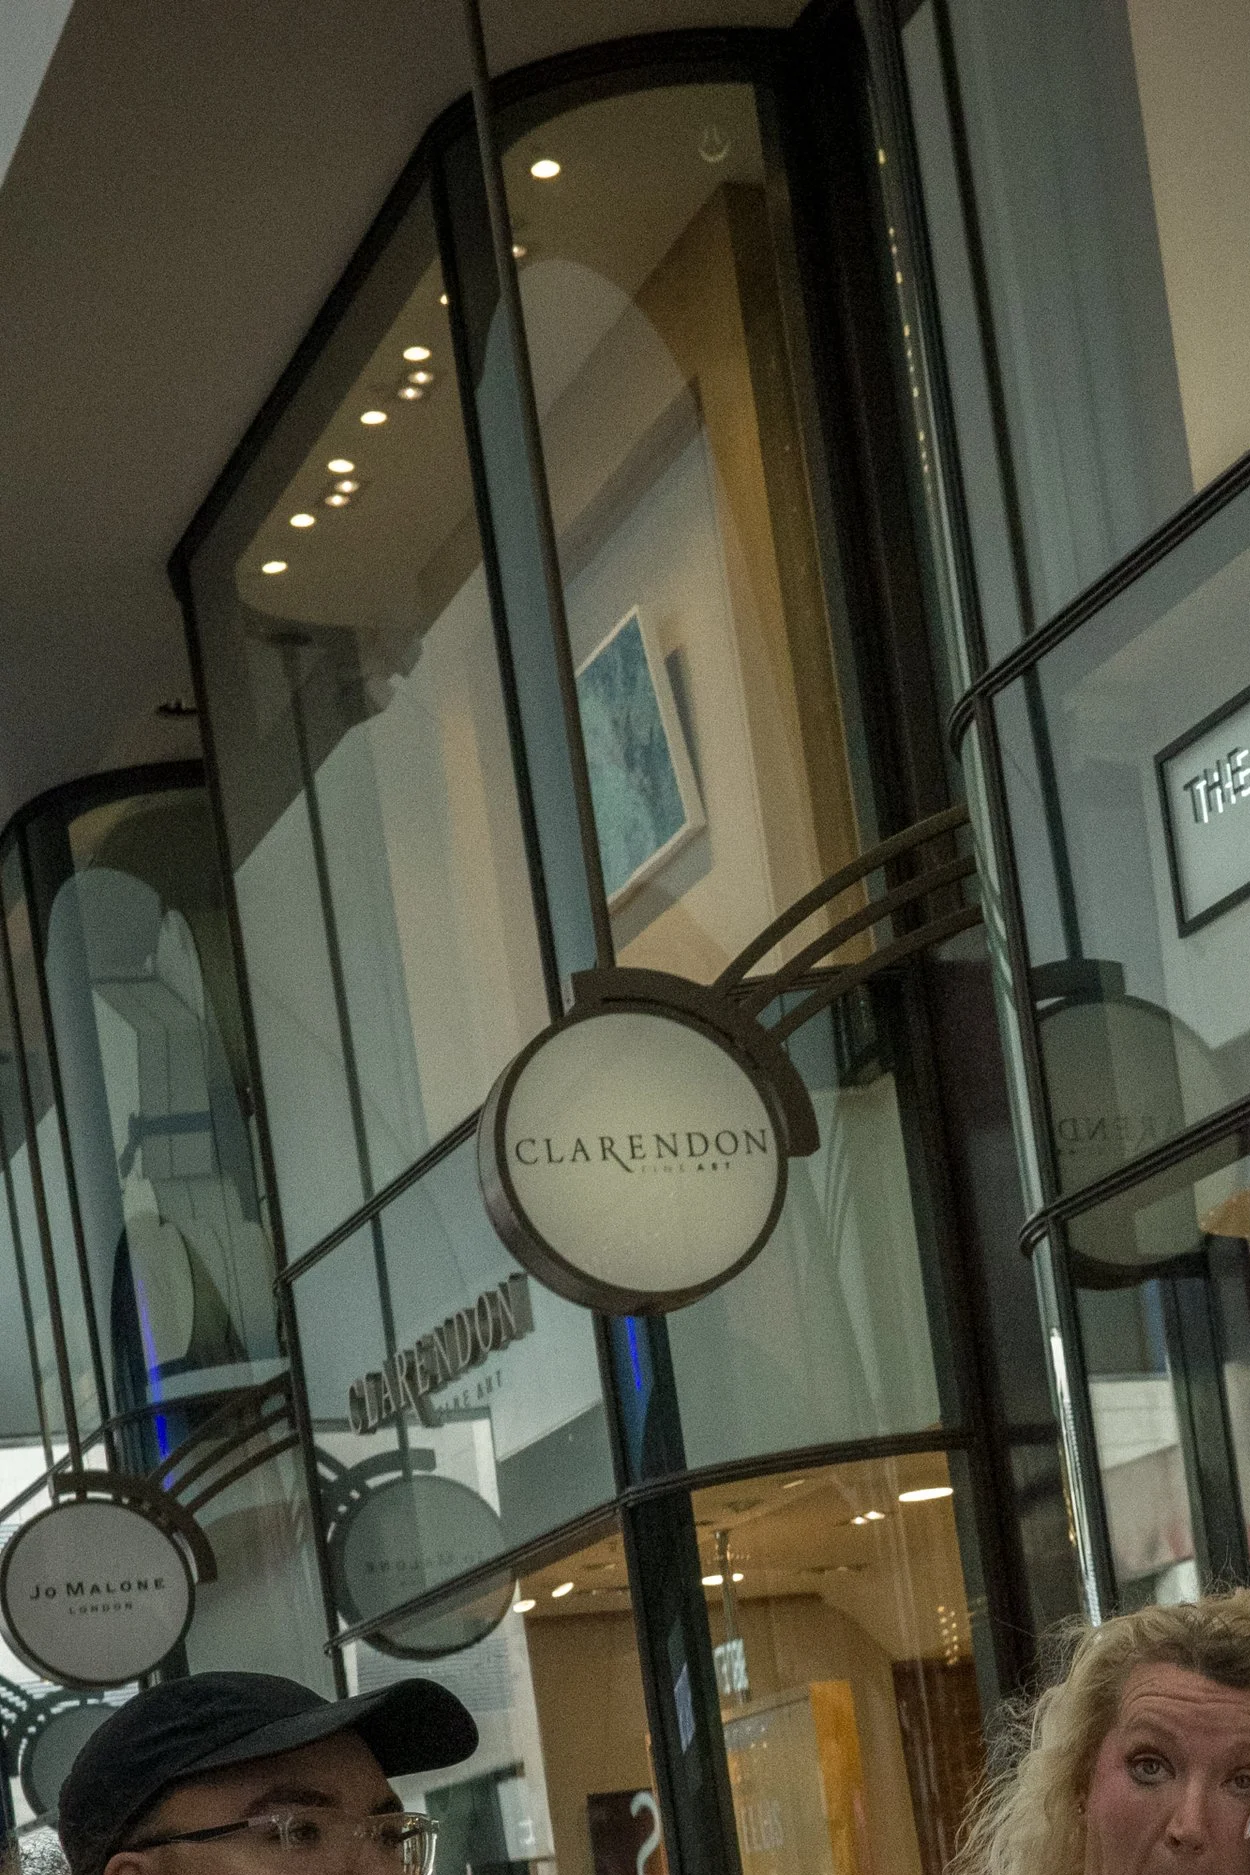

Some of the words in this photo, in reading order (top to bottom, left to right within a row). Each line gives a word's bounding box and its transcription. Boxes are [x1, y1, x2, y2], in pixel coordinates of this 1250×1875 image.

[515, 1128, 768, 1173] CLARENDON
[348, 1275, 530, 1432] CLARENDON
[66, 1578, 164, 1597] MALONE
